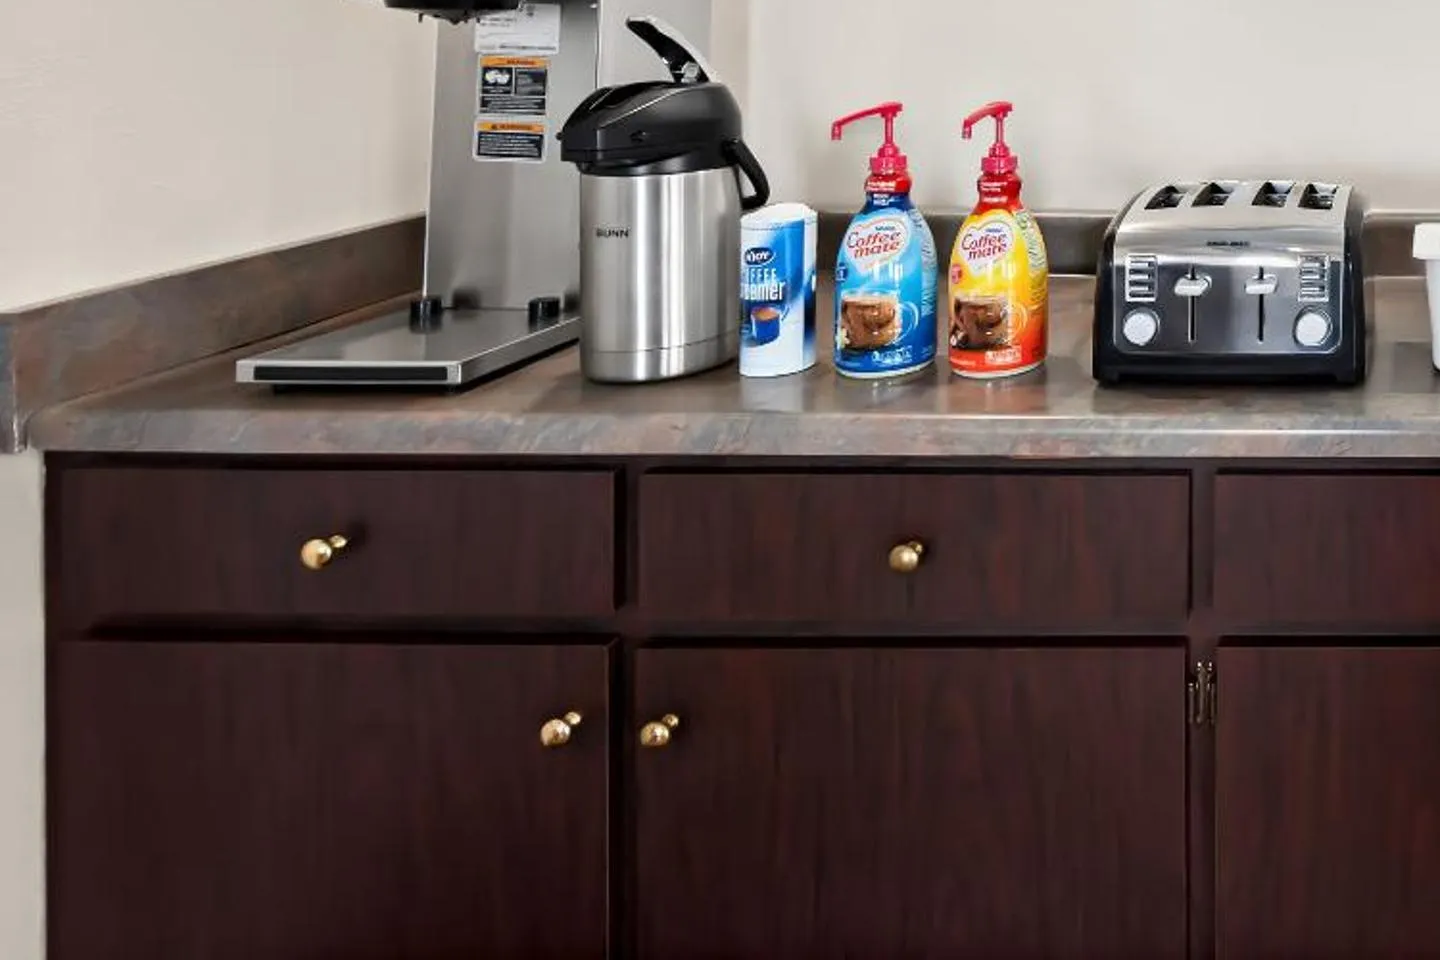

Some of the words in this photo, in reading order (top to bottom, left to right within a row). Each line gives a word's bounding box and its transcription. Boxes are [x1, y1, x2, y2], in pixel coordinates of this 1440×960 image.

[847, 231, 901, 248] Coffee
[962, 234, 1007, 250] Coffee
[855, 241, 900, 258] mate
[968, 243, 1007, 260] mate
